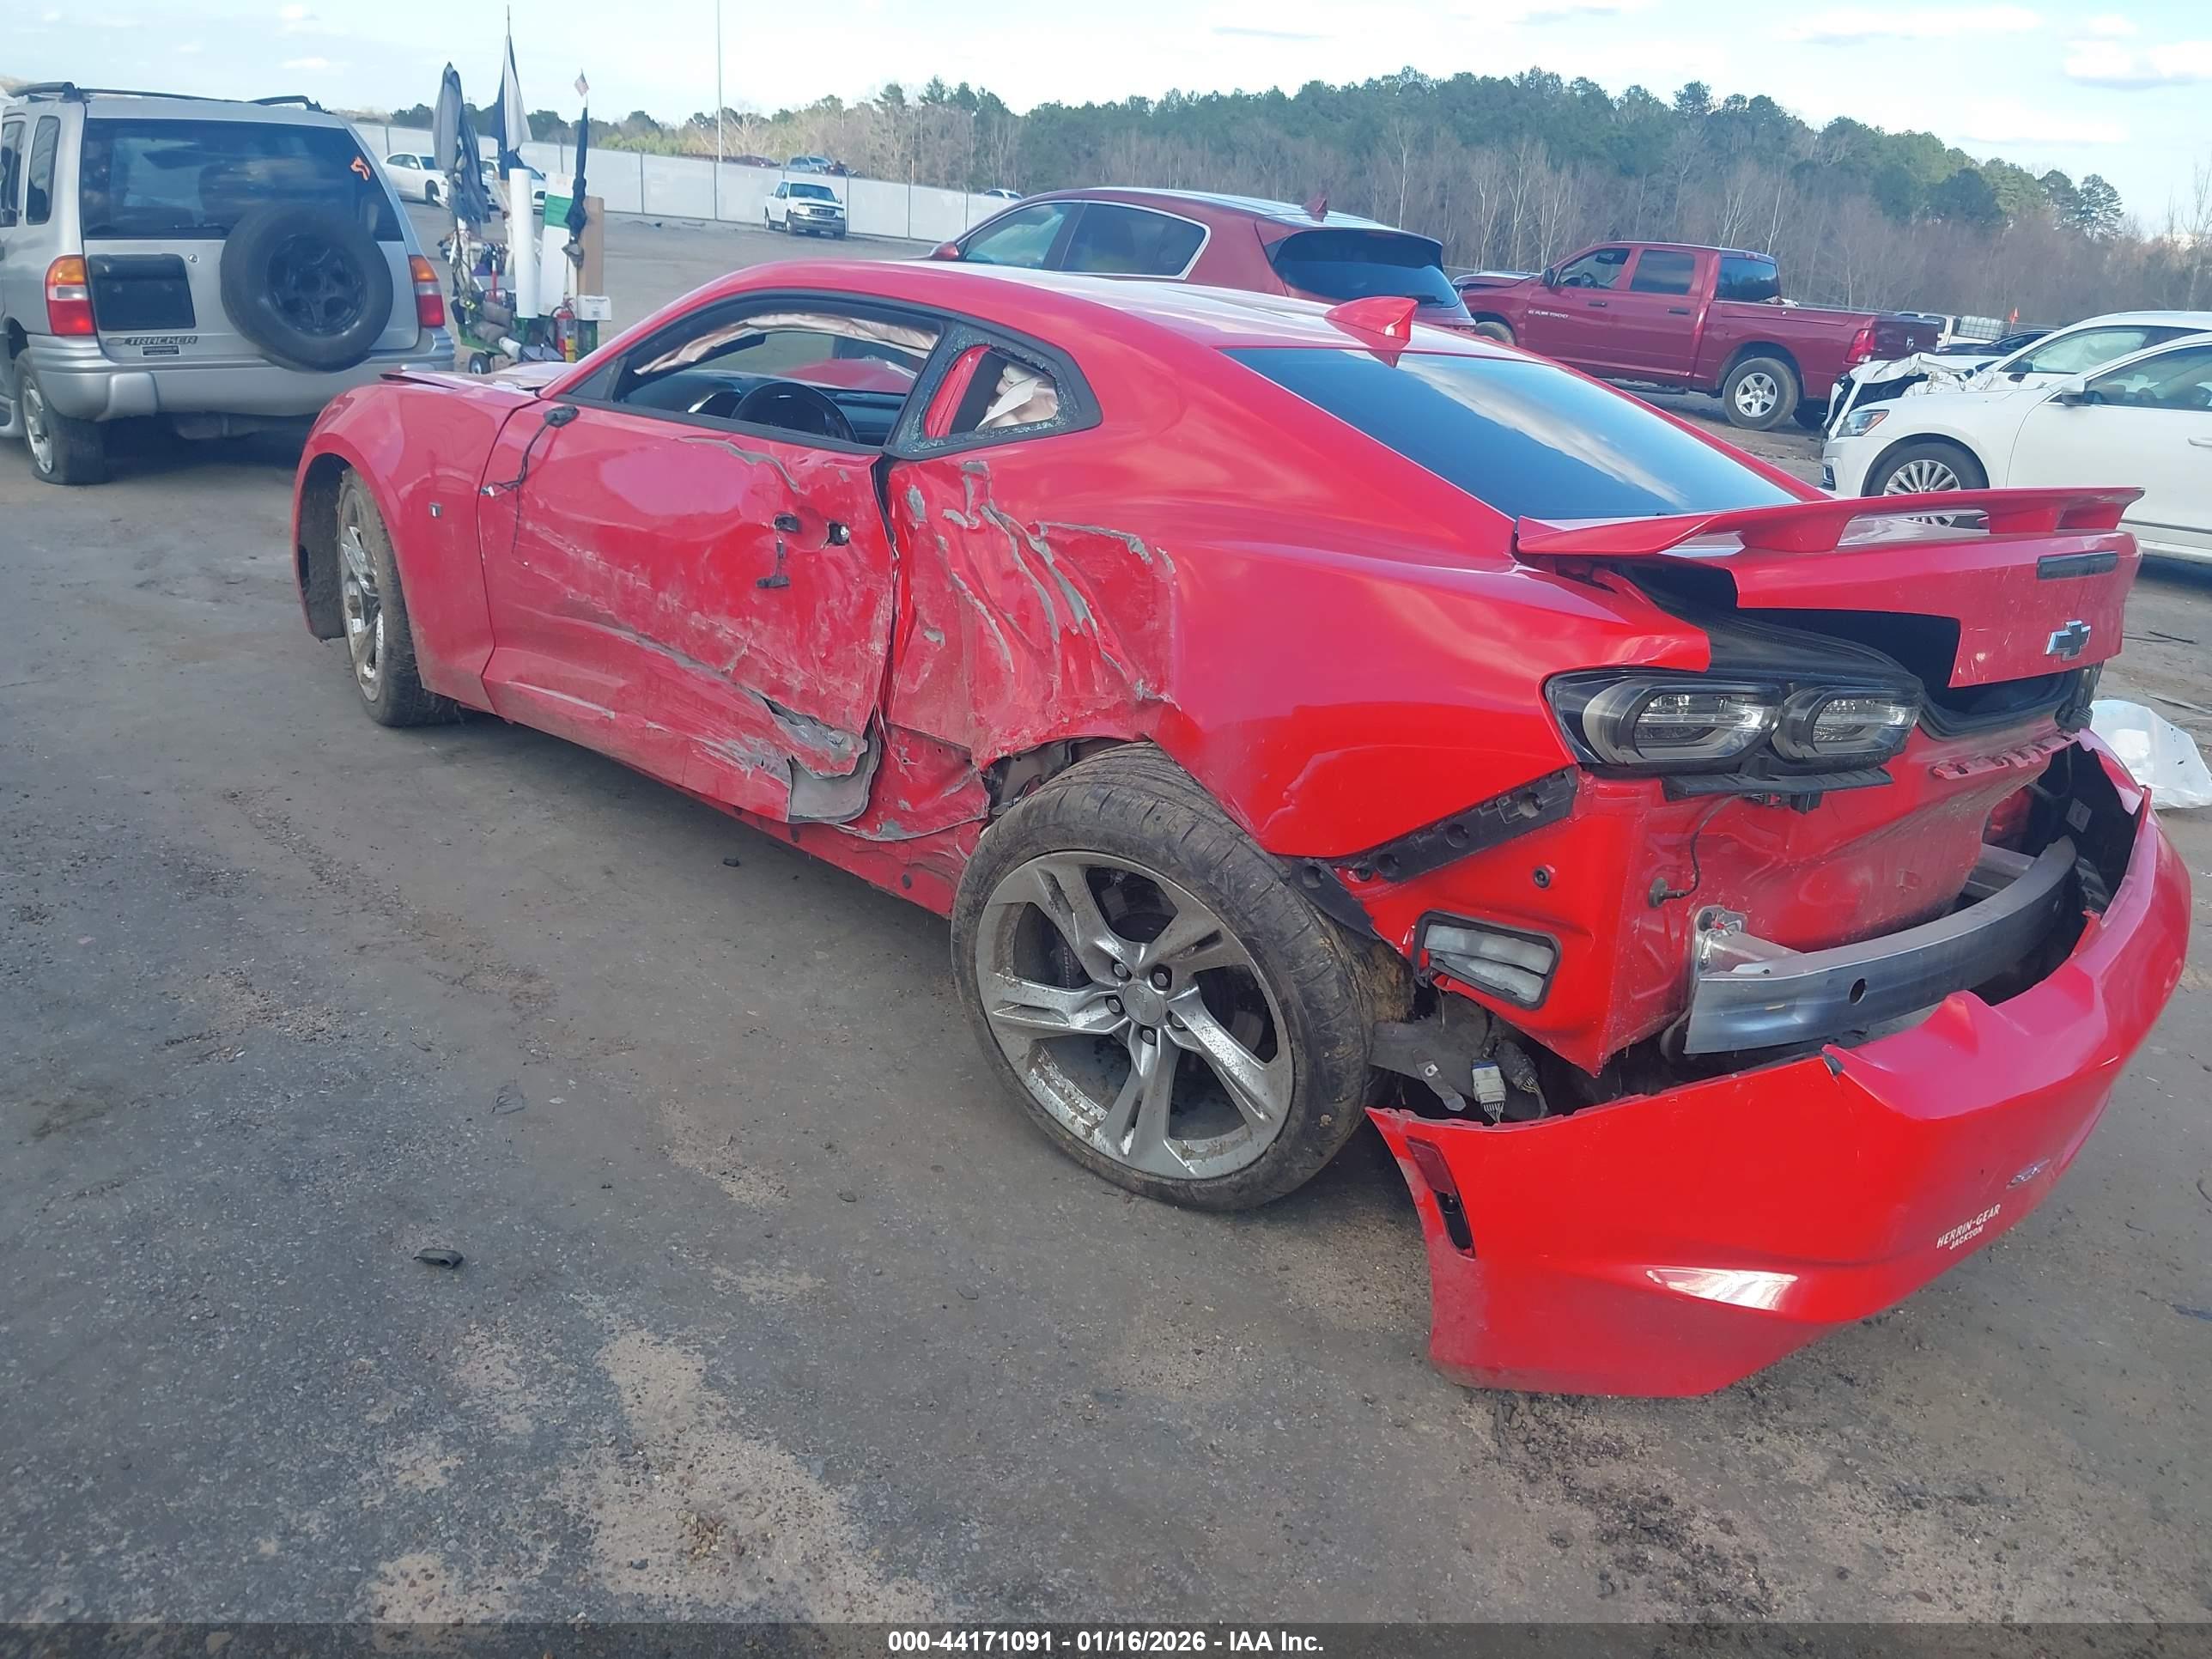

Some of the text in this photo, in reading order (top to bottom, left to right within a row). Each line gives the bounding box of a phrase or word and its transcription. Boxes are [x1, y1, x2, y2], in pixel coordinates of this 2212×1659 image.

[126, 335, 198, 345] TRACKER
[1936, 1203, 2002, 1249] HERRIN-GEAR
[1949, 1224, 1984, 1250] JACKSON
